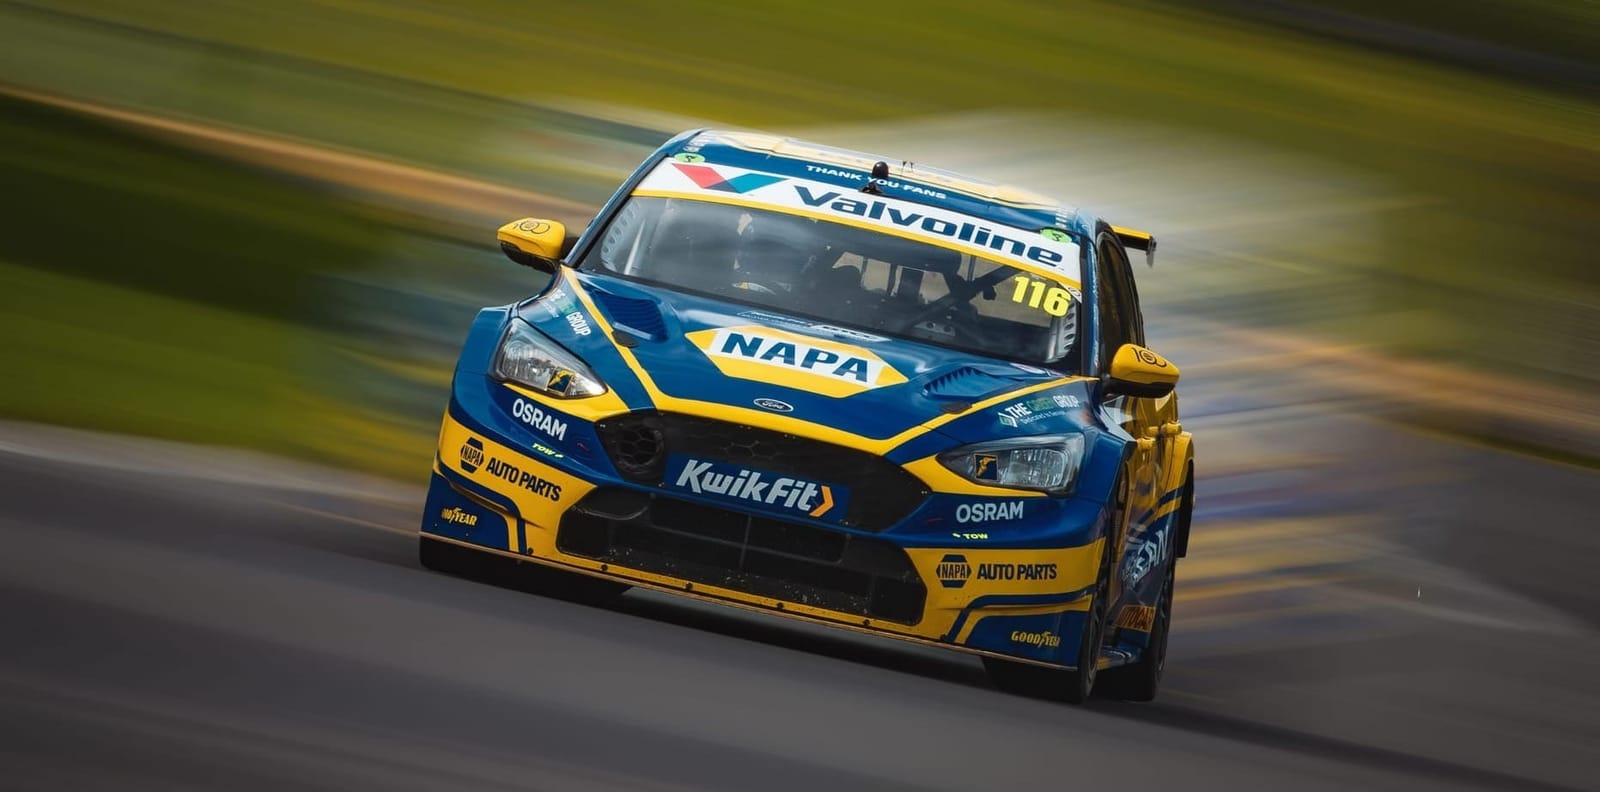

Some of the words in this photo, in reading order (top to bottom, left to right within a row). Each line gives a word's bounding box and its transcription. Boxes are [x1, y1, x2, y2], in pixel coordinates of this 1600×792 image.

[806, 165, 862, 181] THANK
[868, 175, 901, 190] YOU
[903, 184, 947, 200] FANS
[793, 185, 1063, 267] Valvoline
[1012, 276, 1072, 317] 116
[721, 333, 868, 383] NAPA
[512, 398, 568, 441] OSRAM
[1004, 402, 1032, 419] THE
[532, 442, 556, 456] TOW
[462, 445, 482, 467] NAPA
[485, 457, 520, 483] AUTO
[519, 471, 562, 502] PARTS
[955, 501, 1024, 523] OSRAM
[940, 564, 968, 579] NAPA
[977, 563, 1015, 580] AUTO
[1016, 563, 1057, 580] PARTS
